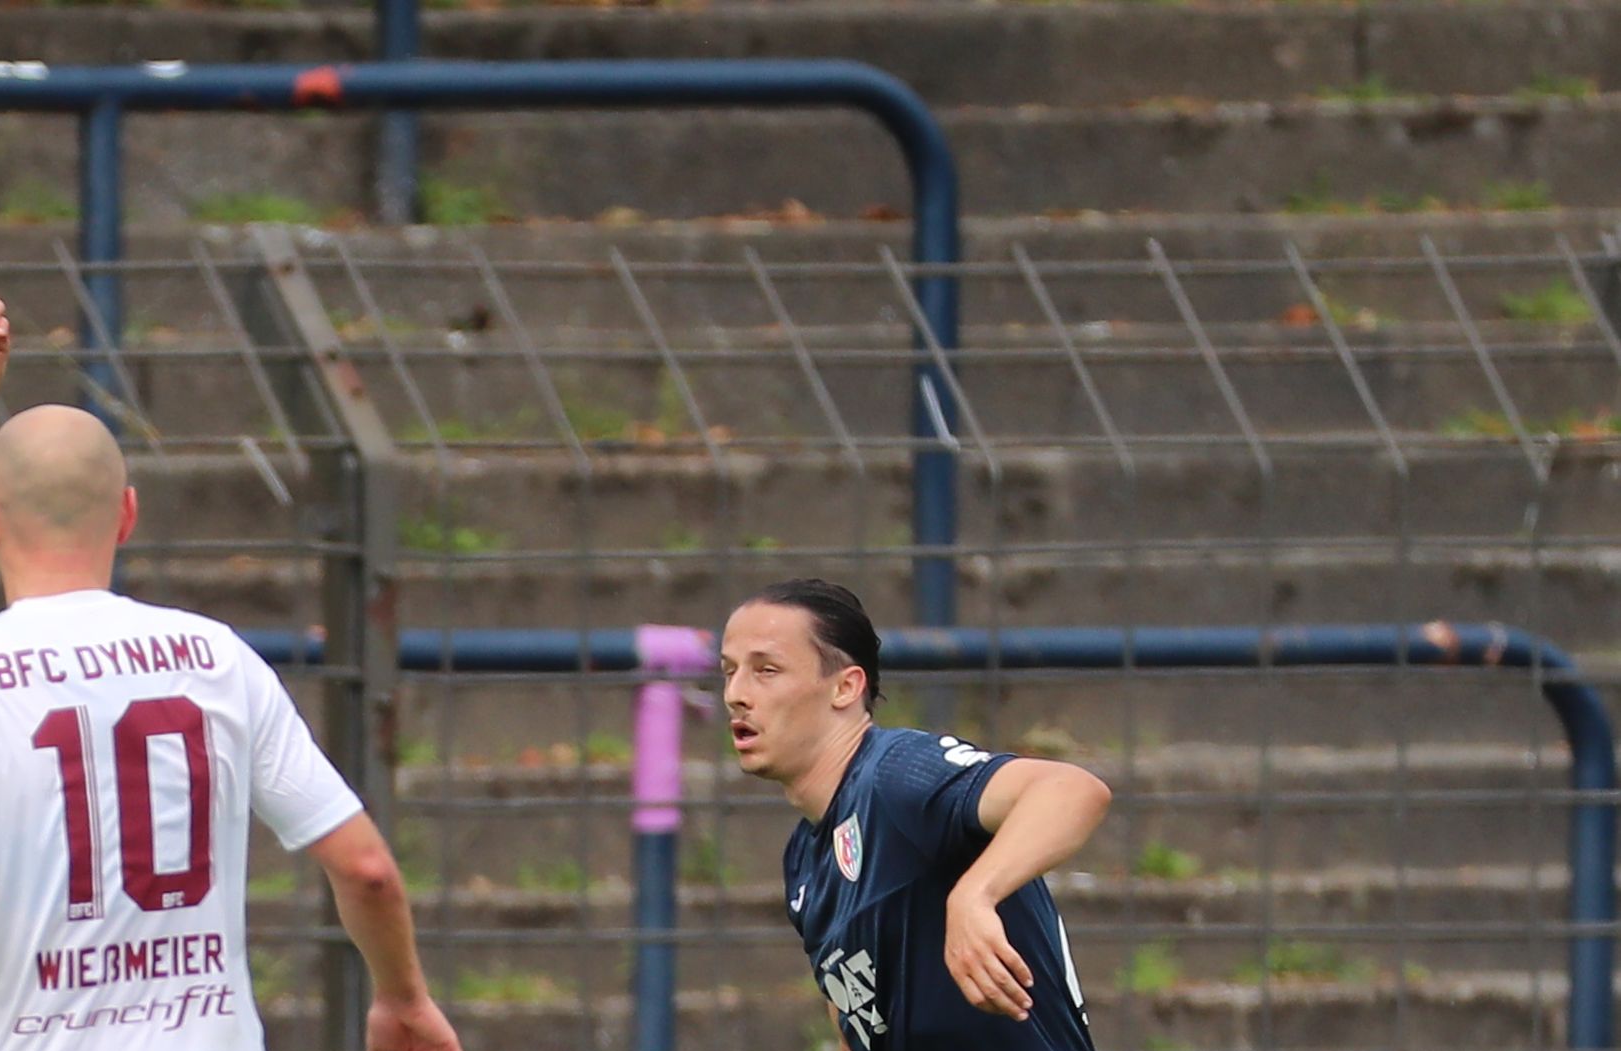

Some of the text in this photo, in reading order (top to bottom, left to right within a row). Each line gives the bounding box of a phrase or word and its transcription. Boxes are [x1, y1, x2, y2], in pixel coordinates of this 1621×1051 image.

[79, 634, 216, 681] DYNAMO
[31, 694, 219, 921] 10
[12, 983, 236, 1036] crunchfit
